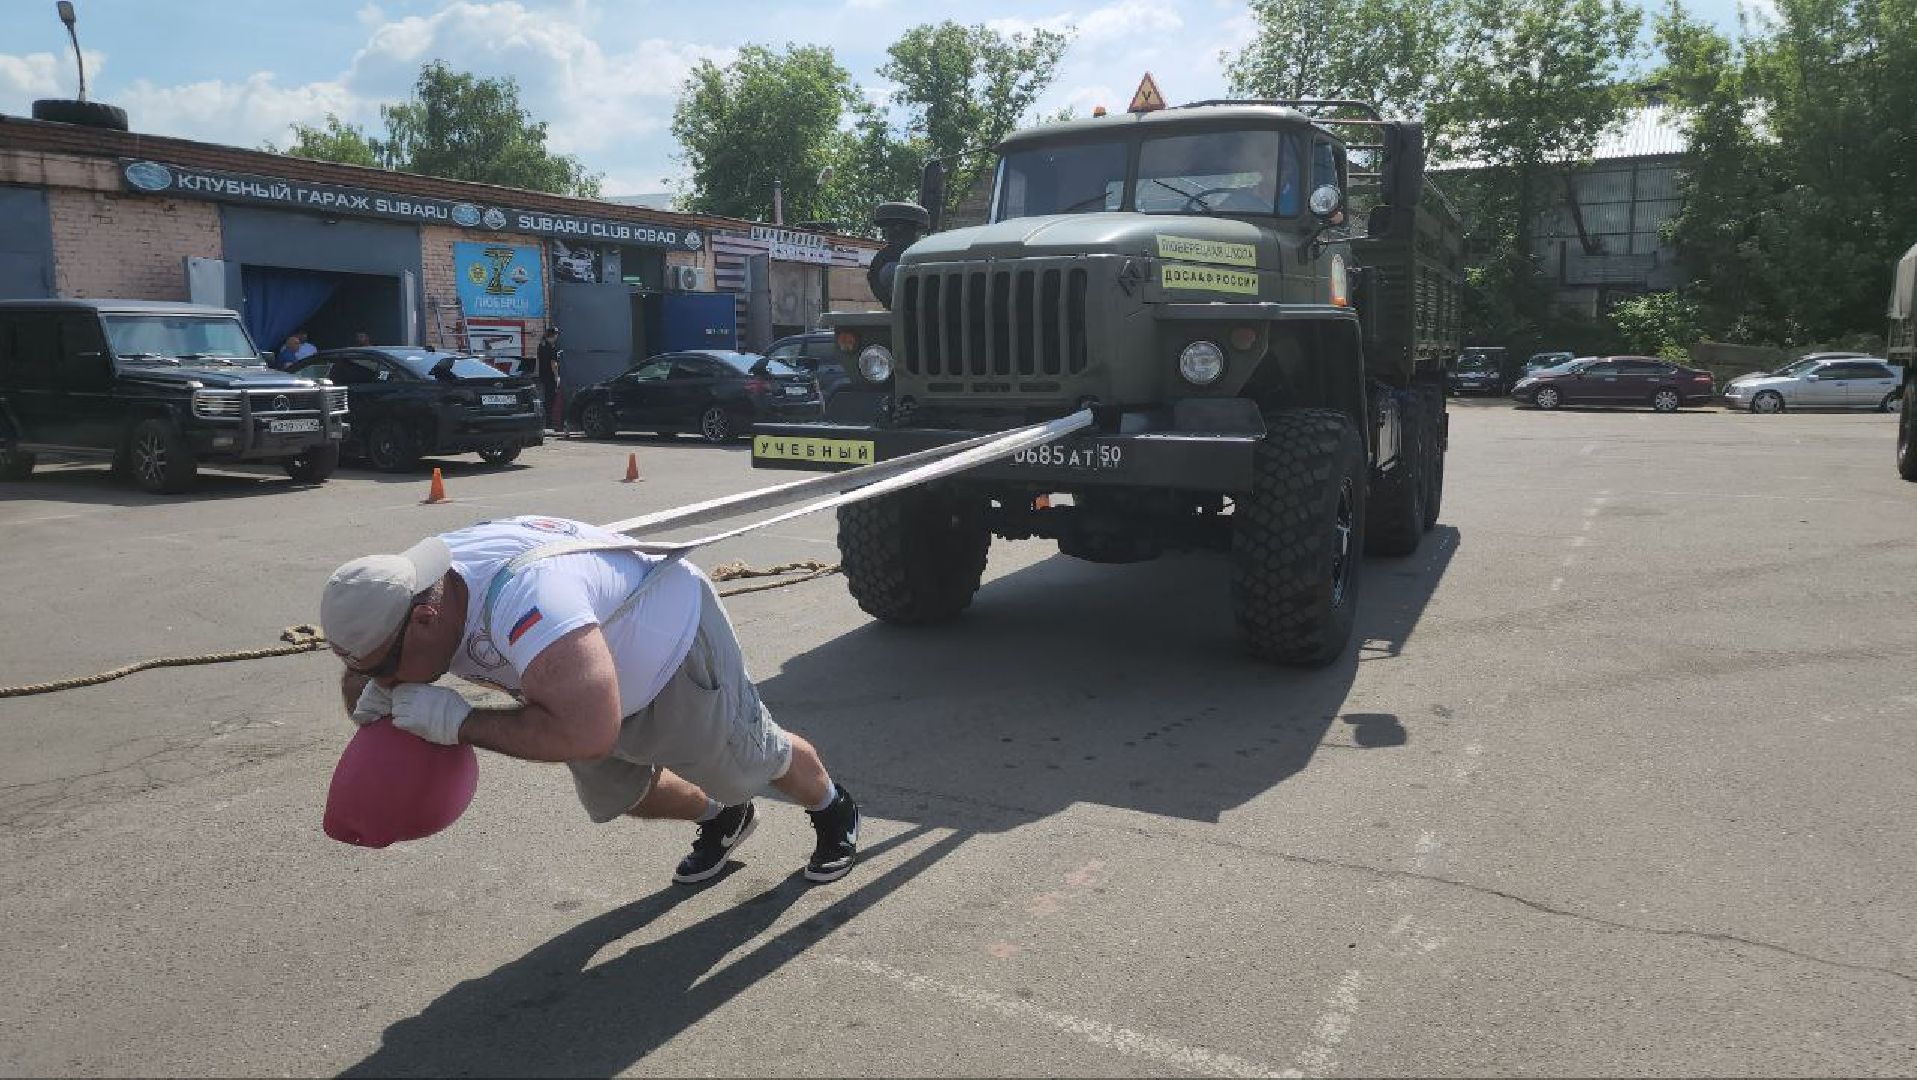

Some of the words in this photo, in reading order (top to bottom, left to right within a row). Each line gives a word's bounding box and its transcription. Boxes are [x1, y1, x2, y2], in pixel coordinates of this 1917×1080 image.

[177, 174, 291, 201] КЛУБНЫЙ
[297, 189, 370, 210] ГАРАЖ
[376, 199, 448, 219] SUBARU
[518, 215, 588, 234] SUBARU
[591, 223, 630, 239] CLUB
[1165, 270, 1212, 284] ДОСААФ
[1216, 275, 1256, 288] РОССИИ
[761, 442, 868, 459] УЧЕБНЫЙ
